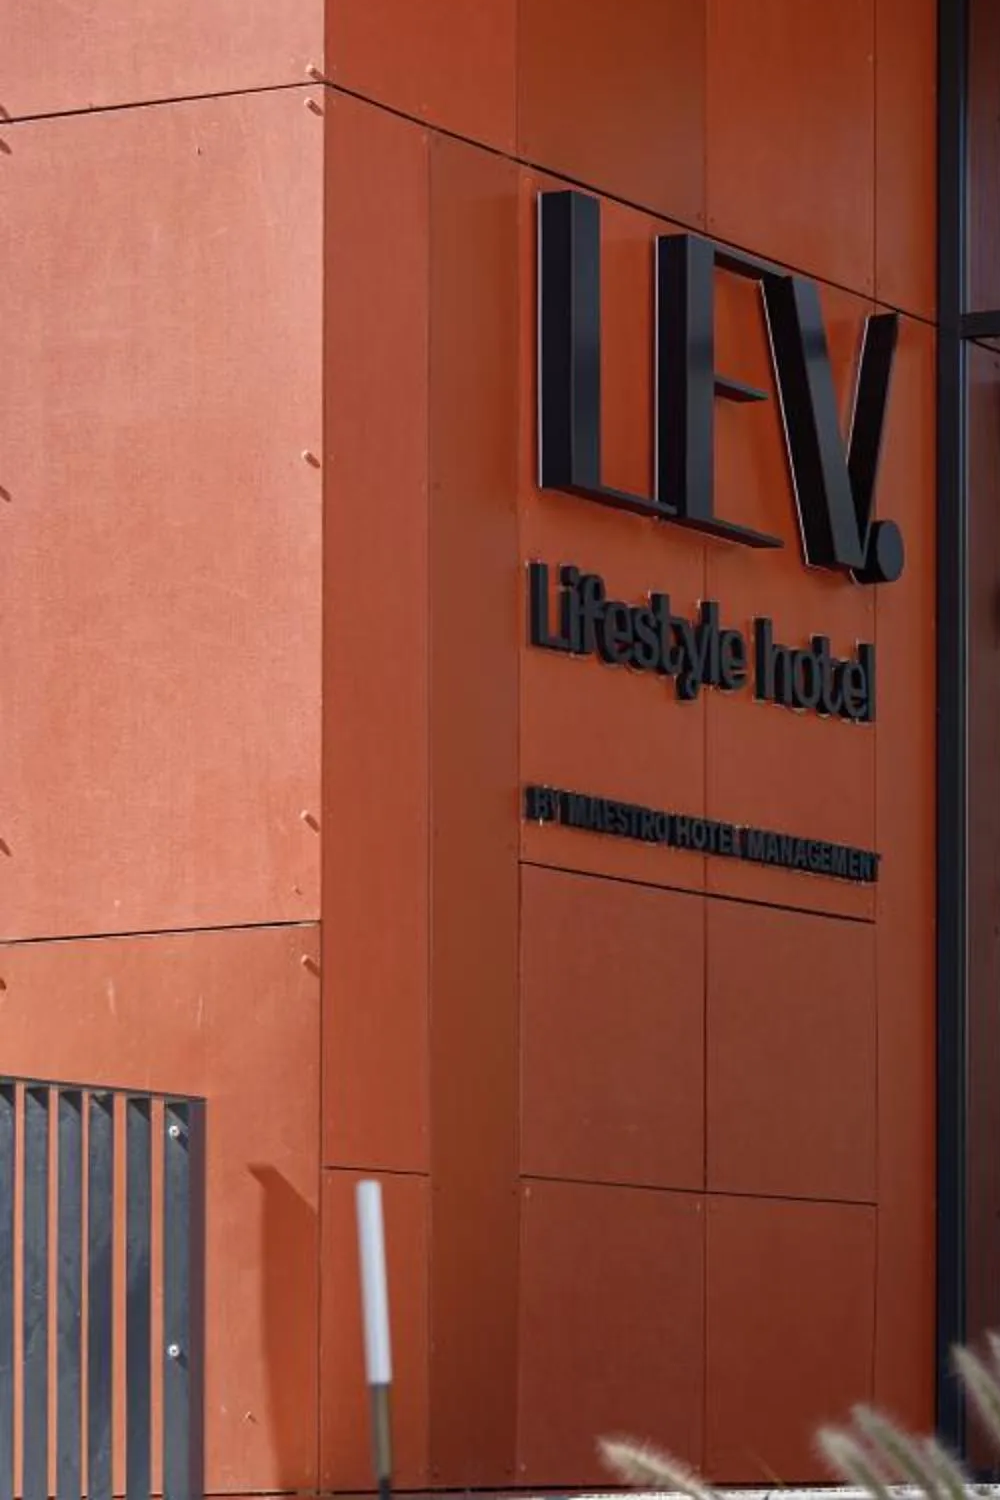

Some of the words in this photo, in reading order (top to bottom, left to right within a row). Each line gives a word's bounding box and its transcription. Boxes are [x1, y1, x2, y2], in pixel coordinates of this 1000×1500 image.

[538, 190, 905, 585] LEV.
[527, 561, 747, 700] Lifestyle
[753, 616, 875, 723] hotel
[526, 786, 561, 822] BY
[561, 791, 669, 846] MAESTRO
[669, 813, 743, 859] HOTEL
[743, 827, 880, 883] MANAGEMENT
